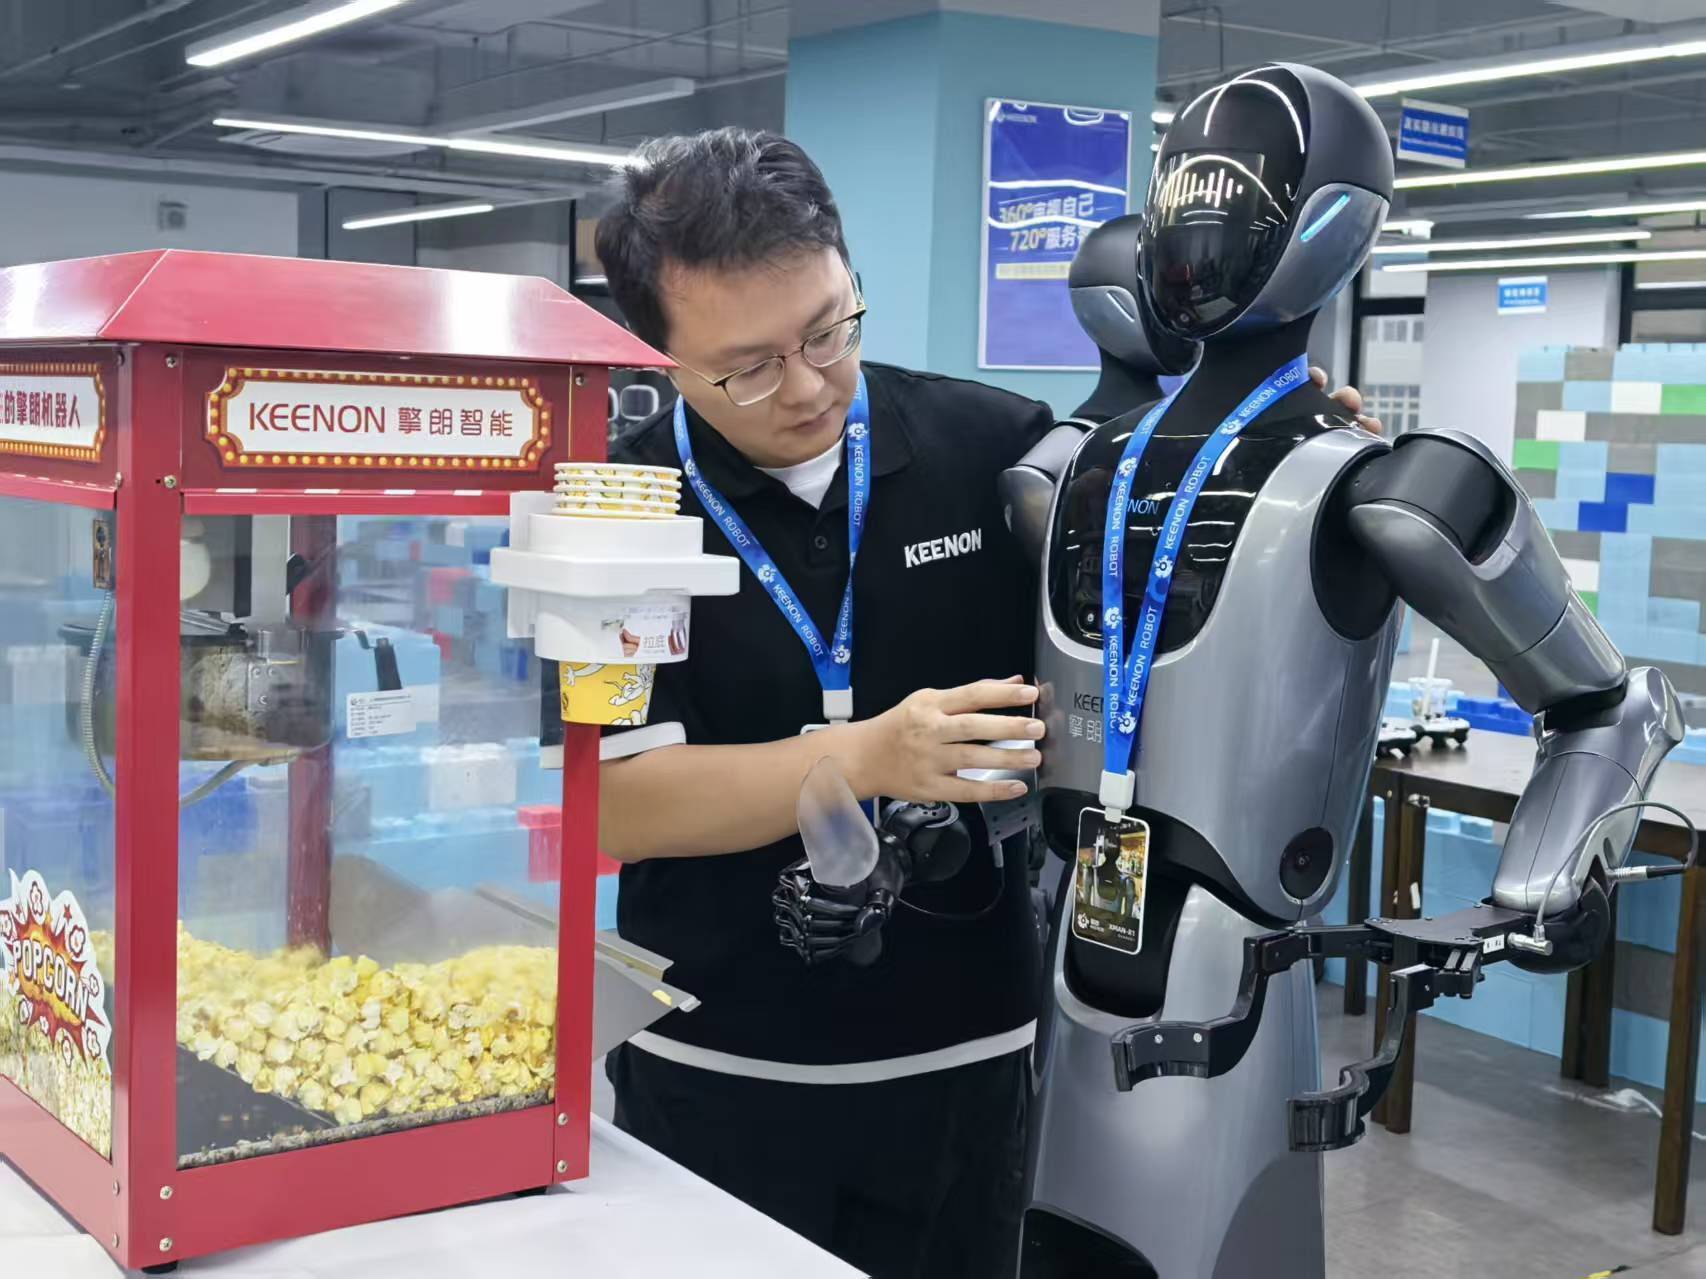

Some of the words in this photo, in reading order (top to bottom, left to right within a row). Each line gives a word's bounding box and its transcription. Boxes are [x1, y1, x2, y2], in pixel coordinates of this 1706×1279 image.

[0, 390, 81, 429] 的擎朗机器人
[1240, 386, 1277, 418] KEENON
[1274, 367, 1301, 388] ROBOT
[249, 402, 386, 433] KEENON
[398, 407, 513, 437] 擎朗智能
[854, 444, 864, 486] KEENON
[696, 478, 726, 516] KEENON
[724, 516, 751, 547] ROBOT
[853, 492, 864, 526] ROBOT
[1111, 481, 1128, 530] KEENON
[1164, 499, 1190, 550] KEENON
[1184, 456, 1211, 493] ROBOT
[904, 528, 982, 568] KEENON
[1109, 536, 1119, 577] ROBOT
[773, 584, 802, 623] KEENON
[801, 624, 823, 656] ROBOT
[840, 597, 849, 640] KEENON
[1109, 635, 1118, 687] KEENON
[1127, 655, 1146, 706] KEENON
[1140, 606, 1158, 649] ROBOT
[1073, 692, 1104, 714] KEE
[1109, 693, 1119, 734] ROBO
[13, 939, 89, 1025] POPCORN
